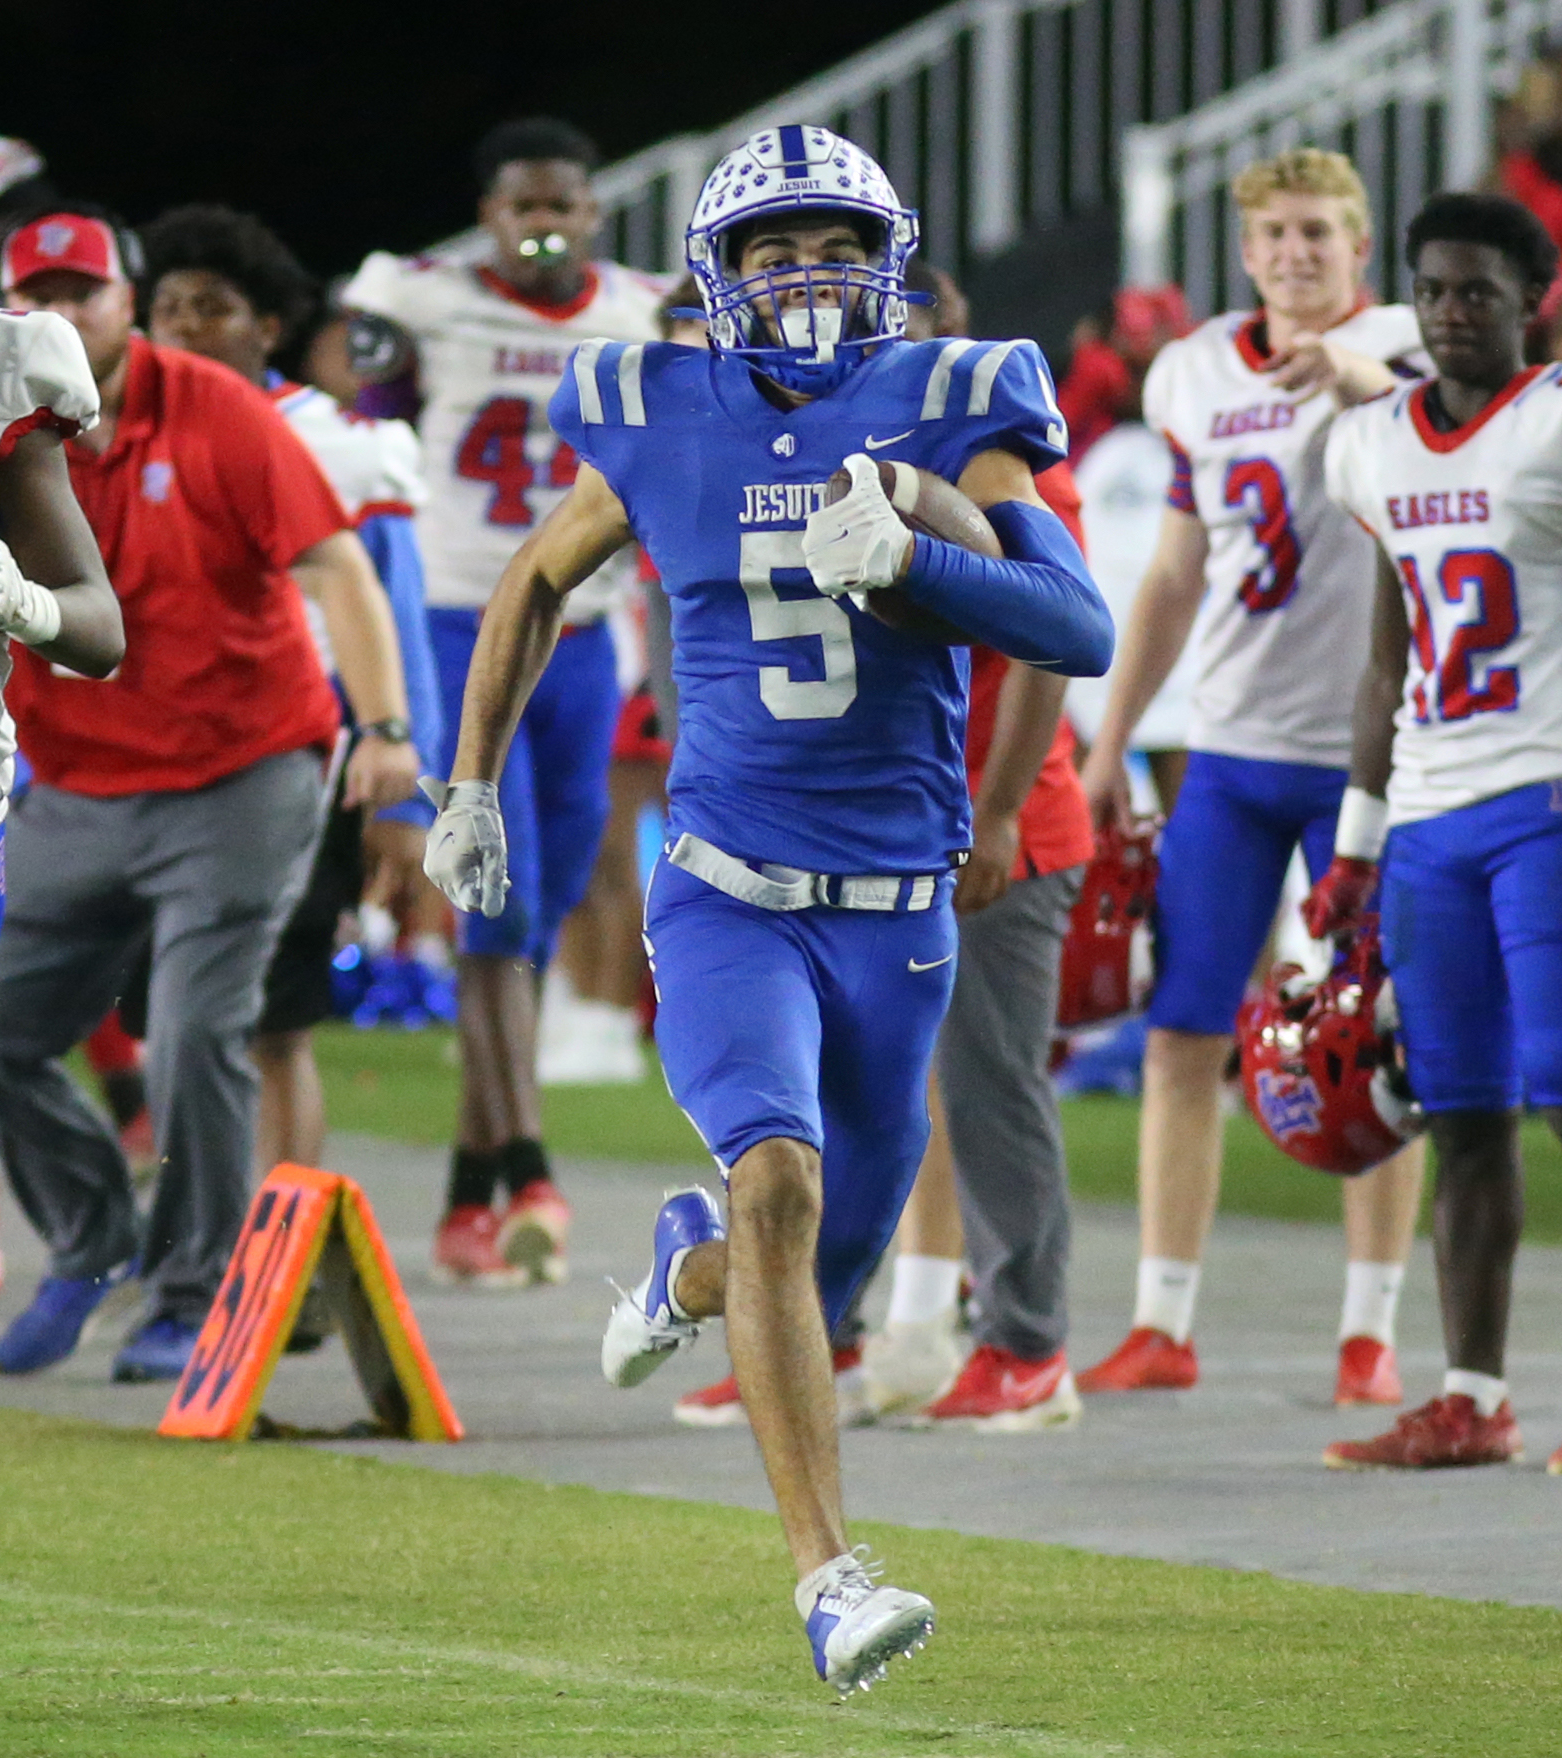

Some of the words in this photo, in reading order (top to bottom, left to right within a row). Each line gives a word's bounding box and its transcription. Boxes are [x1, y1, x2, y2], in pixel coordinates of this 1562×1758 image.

[777, 179, 821, 193] JESUIT
[455, 393, 580, 527] 4
[1209, 403, 1296, 440] EAGLES
[1223, 457, 1302, 614] 3
[1388, 490, 1490, 530] EAGLES
[739, 530, 858, 721] 5
[1397, 547, 1521, 724] 12
[179, 1189, 303, 1412] 50
